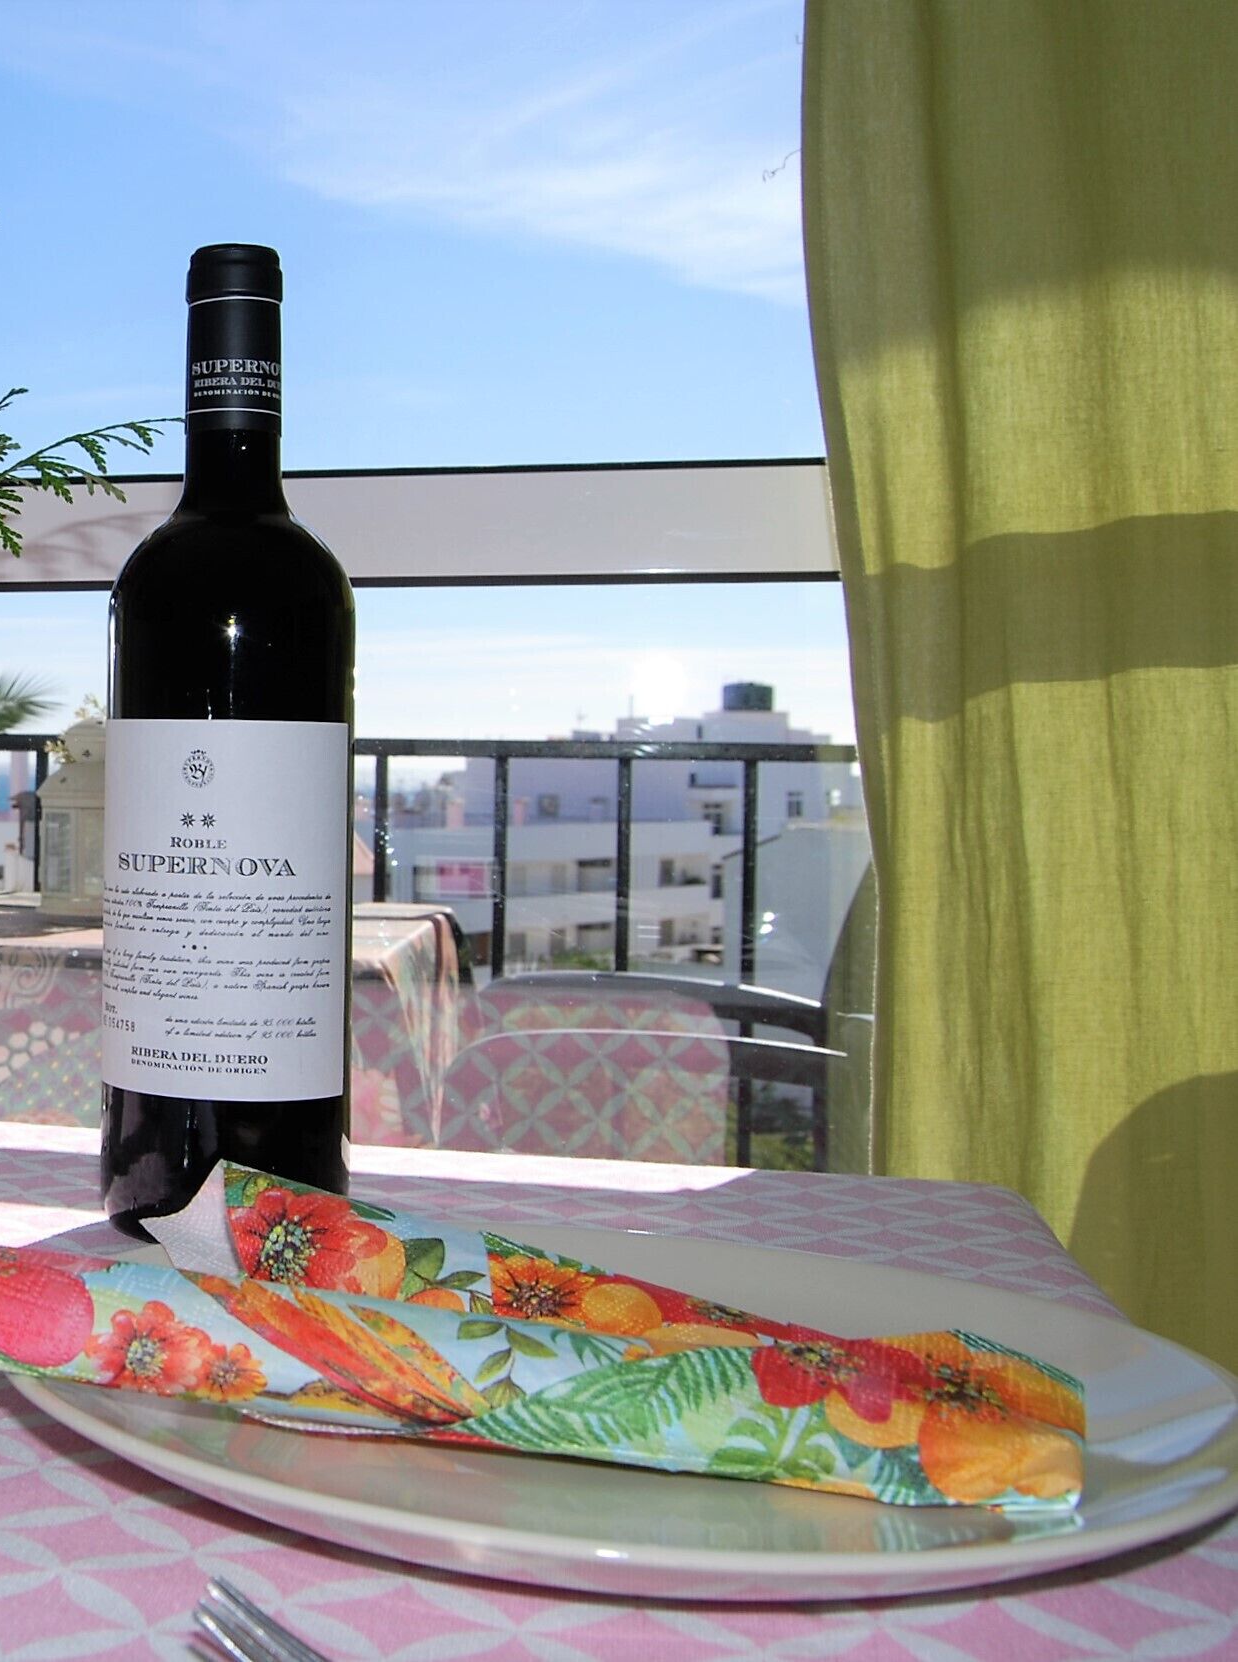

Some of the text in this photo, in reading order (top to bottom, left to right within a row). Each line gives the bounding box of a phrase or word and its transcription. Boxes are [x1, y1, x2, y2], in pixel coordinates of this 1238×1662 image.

[193, 377, 238, 389] RIBERA
[240, 377, 266, 387] DEL
[170, 836, 228, 850] ROBLE
[118, 852, 297, 877] SUPERNOVA
[193, 891, 203, 899] de
[146, 898, 189, 912] Tempranillo
[225, 904, 241, 913] del
[184, 930, 193, 939] y
[299, 929, 314, 937] del
[135, 950, 157, 964] family
[166, 978, 181, 987] del
[152, 988, 178, 1001] elegant
[131, 1045, 269, 1065] RIBERA DEL DUERO
[208, 1066, 223, 1074] DE
[225, 1067, 267, 1075] ORIGEN
